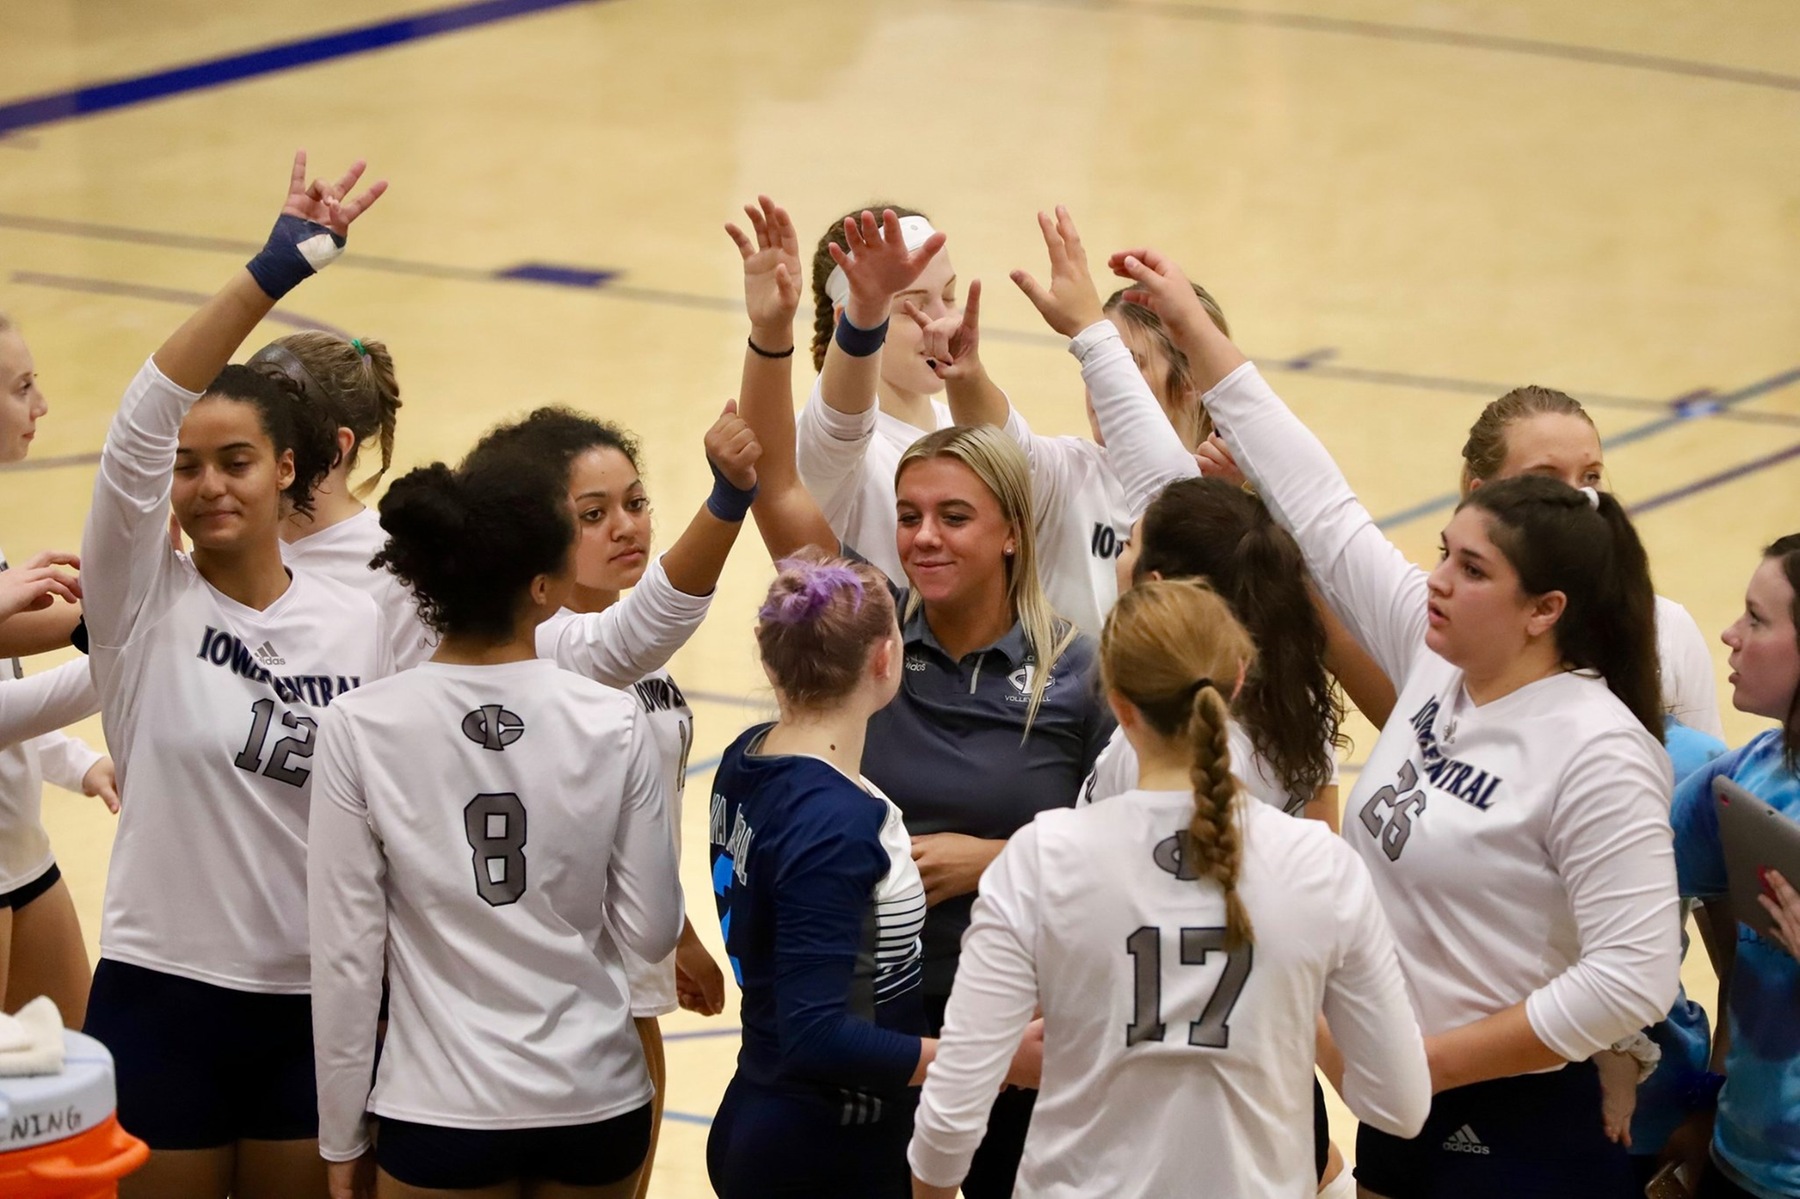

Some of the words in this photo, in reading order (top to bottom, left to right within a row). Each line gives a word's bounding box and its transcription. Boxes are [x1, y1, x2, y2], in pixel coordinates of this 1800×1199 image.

[234, 698, 318, 788] 12
[1004, 694, 1052, 703] VOLLEYLL
[464, 792, 527, 907] 8
[1359, 759, 1427, 862] 26
[1127, 926, 1253, 1048] 17
[1443, 1140, 1490, 1155] adidas
